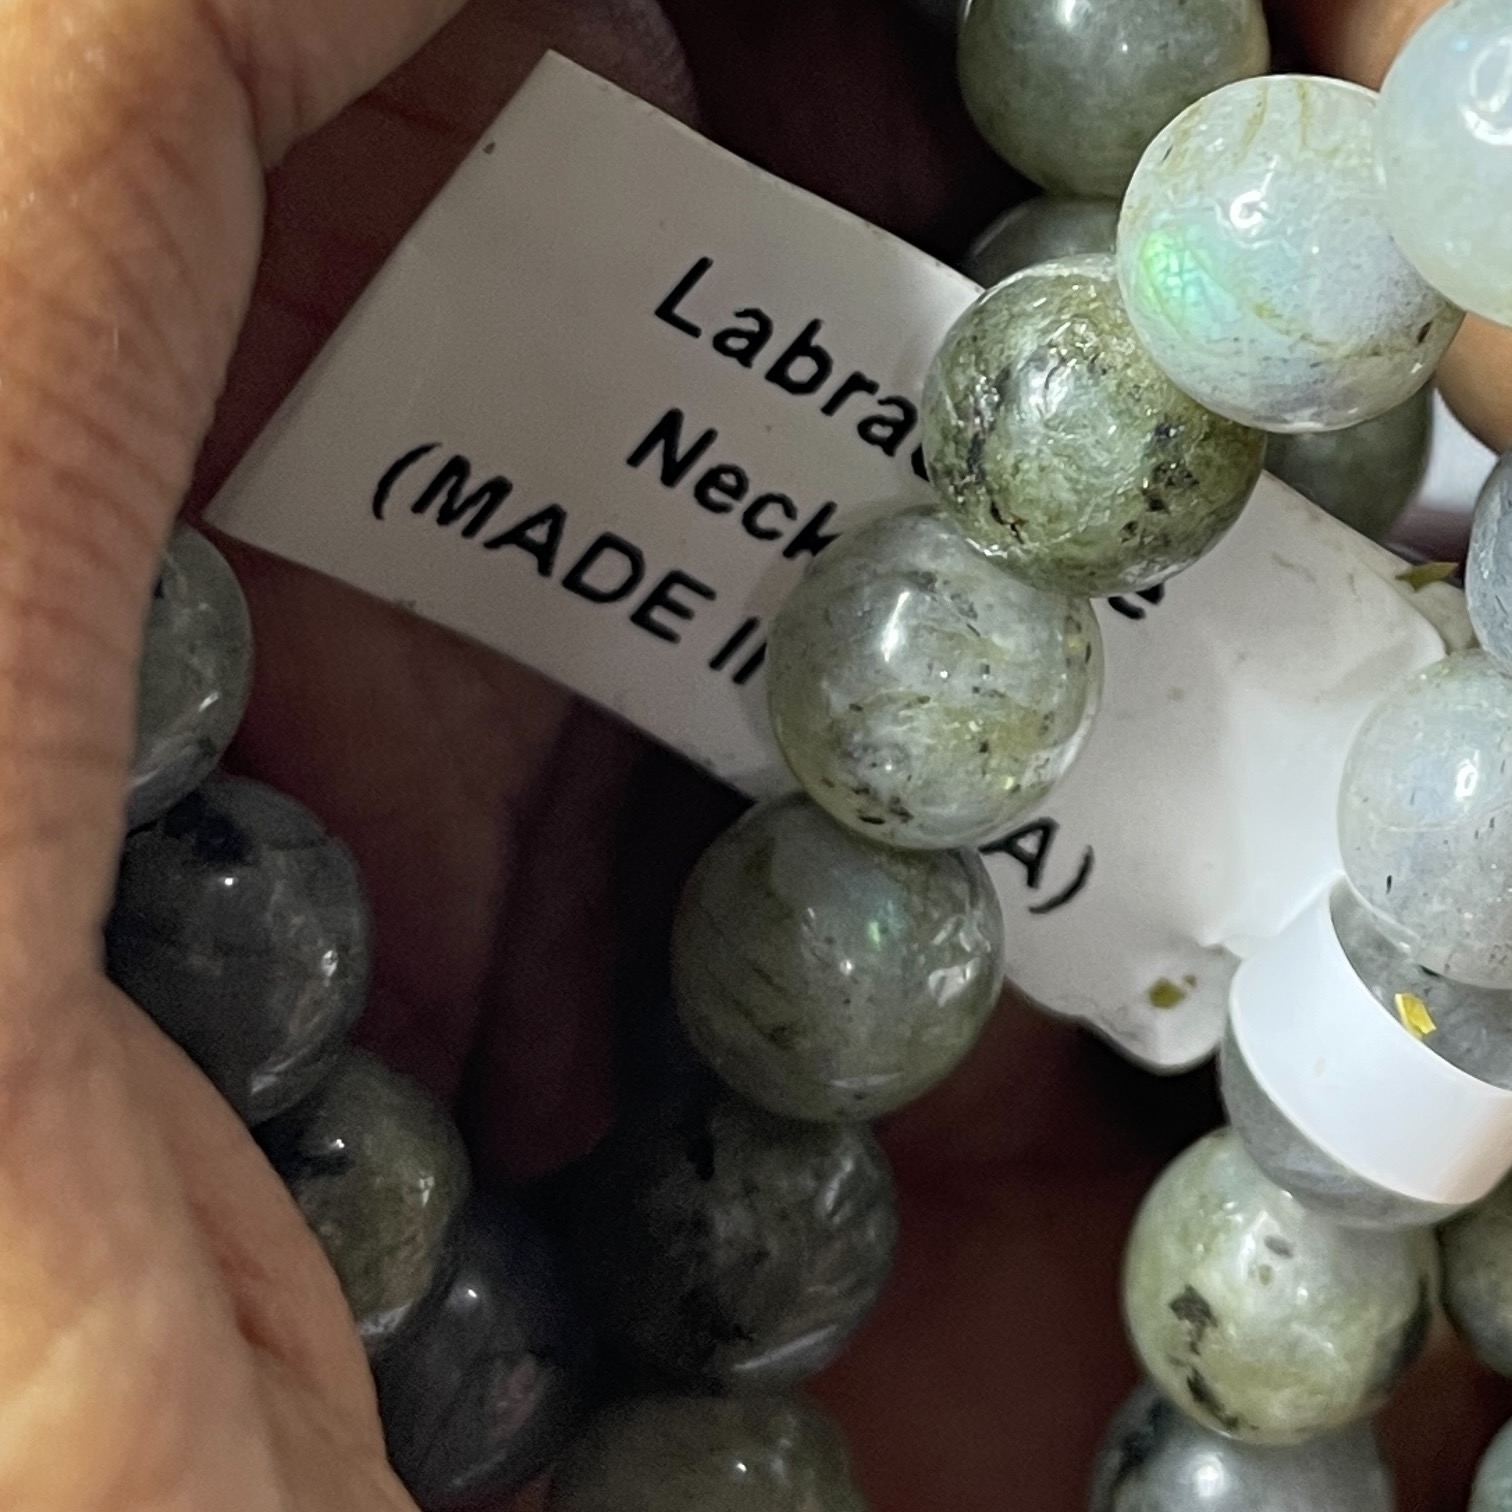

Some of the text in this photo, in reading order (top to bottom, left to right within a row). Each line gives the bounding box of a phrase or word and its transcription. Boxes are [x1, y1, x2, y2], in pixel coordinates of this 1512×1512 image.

[653, 256, 929, 484] Labra
[371, 442, 718, 646] (MADE
[625, 407, 842, 562] Neck
